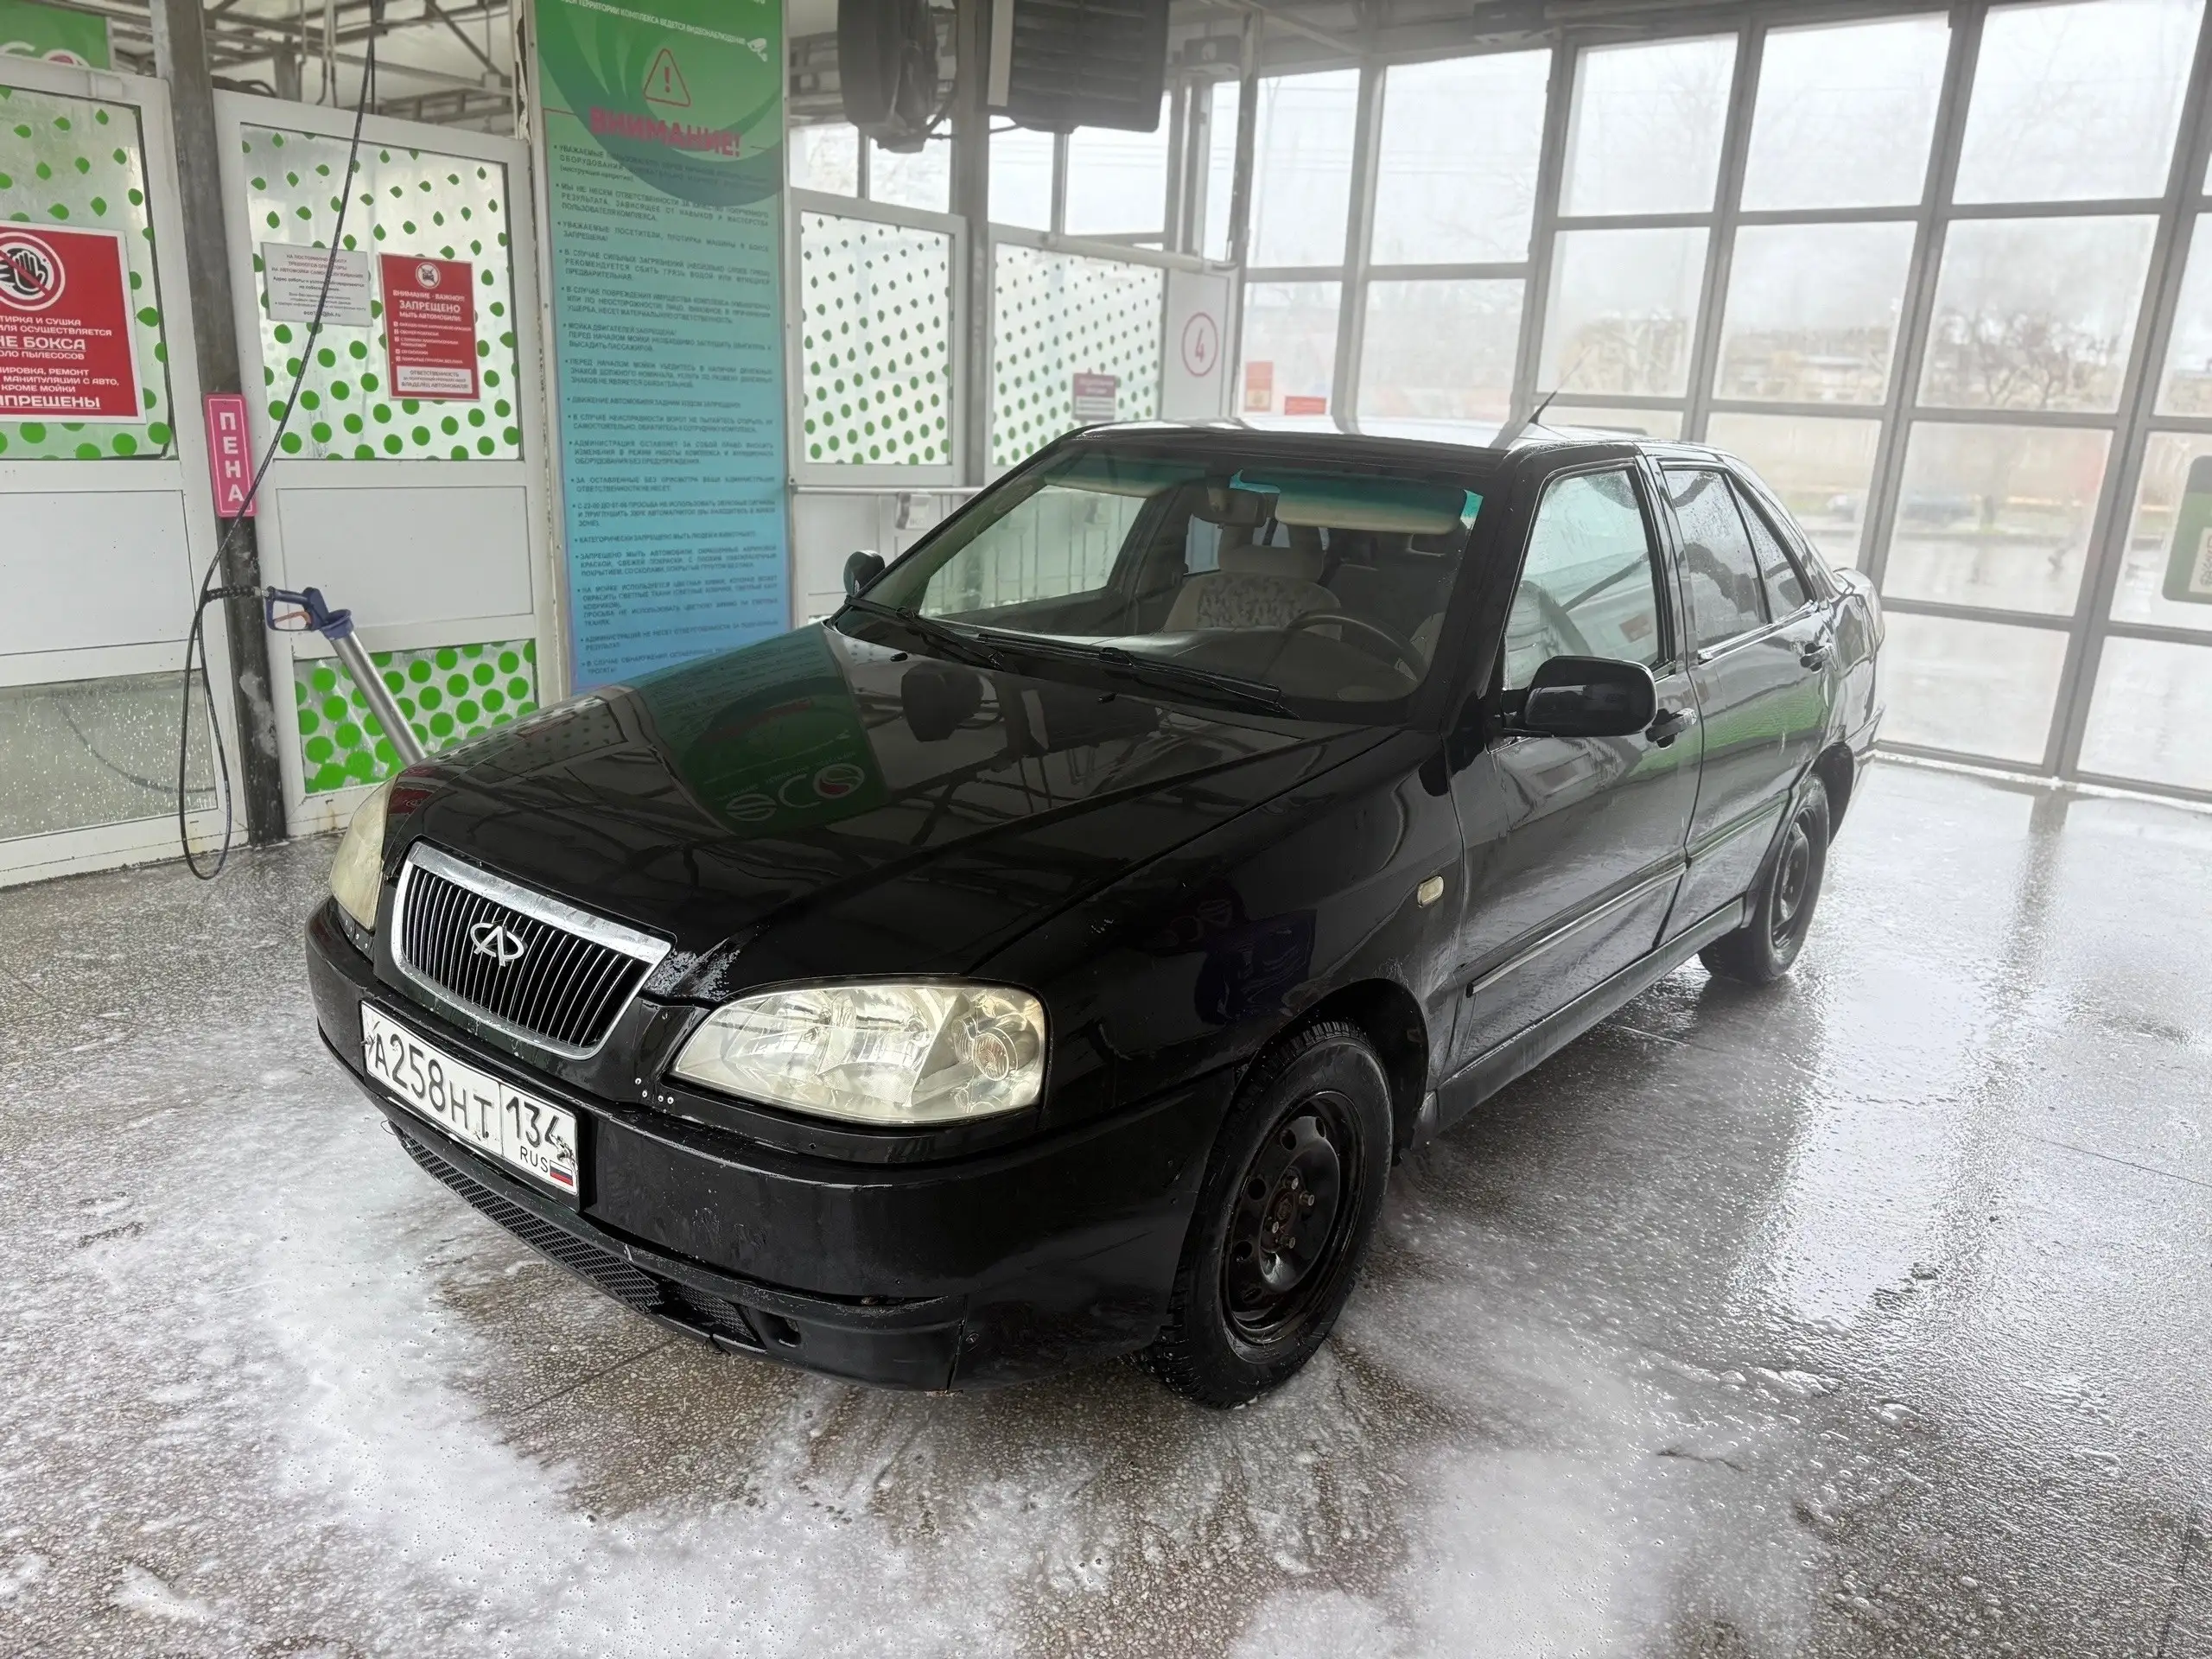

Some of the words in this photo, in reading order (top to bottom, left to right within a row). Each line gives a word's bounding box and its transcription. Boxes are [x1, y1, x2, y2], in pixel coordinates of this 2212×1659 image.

[620, 9, 659, 25] КОМПЛЕКСА
[660, 17, 686, 31] ВЕДЕТСЯ
[590, 105, 740, 157] ВНИМАНИЕ!
[393, 290, 430, 299] ВНИМАНИЕ
[399, 300, 461, 313] ЗАПРЕЩЕНО
[45, 318, 81, 326] СУШКА
[20, 325, 112, 336] ОСУЩЕСТВЛЯЕТСЯ
[23, 336, 86, 350] БОКСА
[1195, 327, 1205, 363] 4
[22, 351, 85, 360] ПЫЛЕСОСОВ
[3, 375, 80, 385] МАНИПУЛЯЦИИ
[1, 384, 38, 392] КРОМЕ
[40, 384, 76, 393] МОЙКИ
[219, 412, 245, 502] ПЕНА
[520, 1146, 549, 1174] RUS
